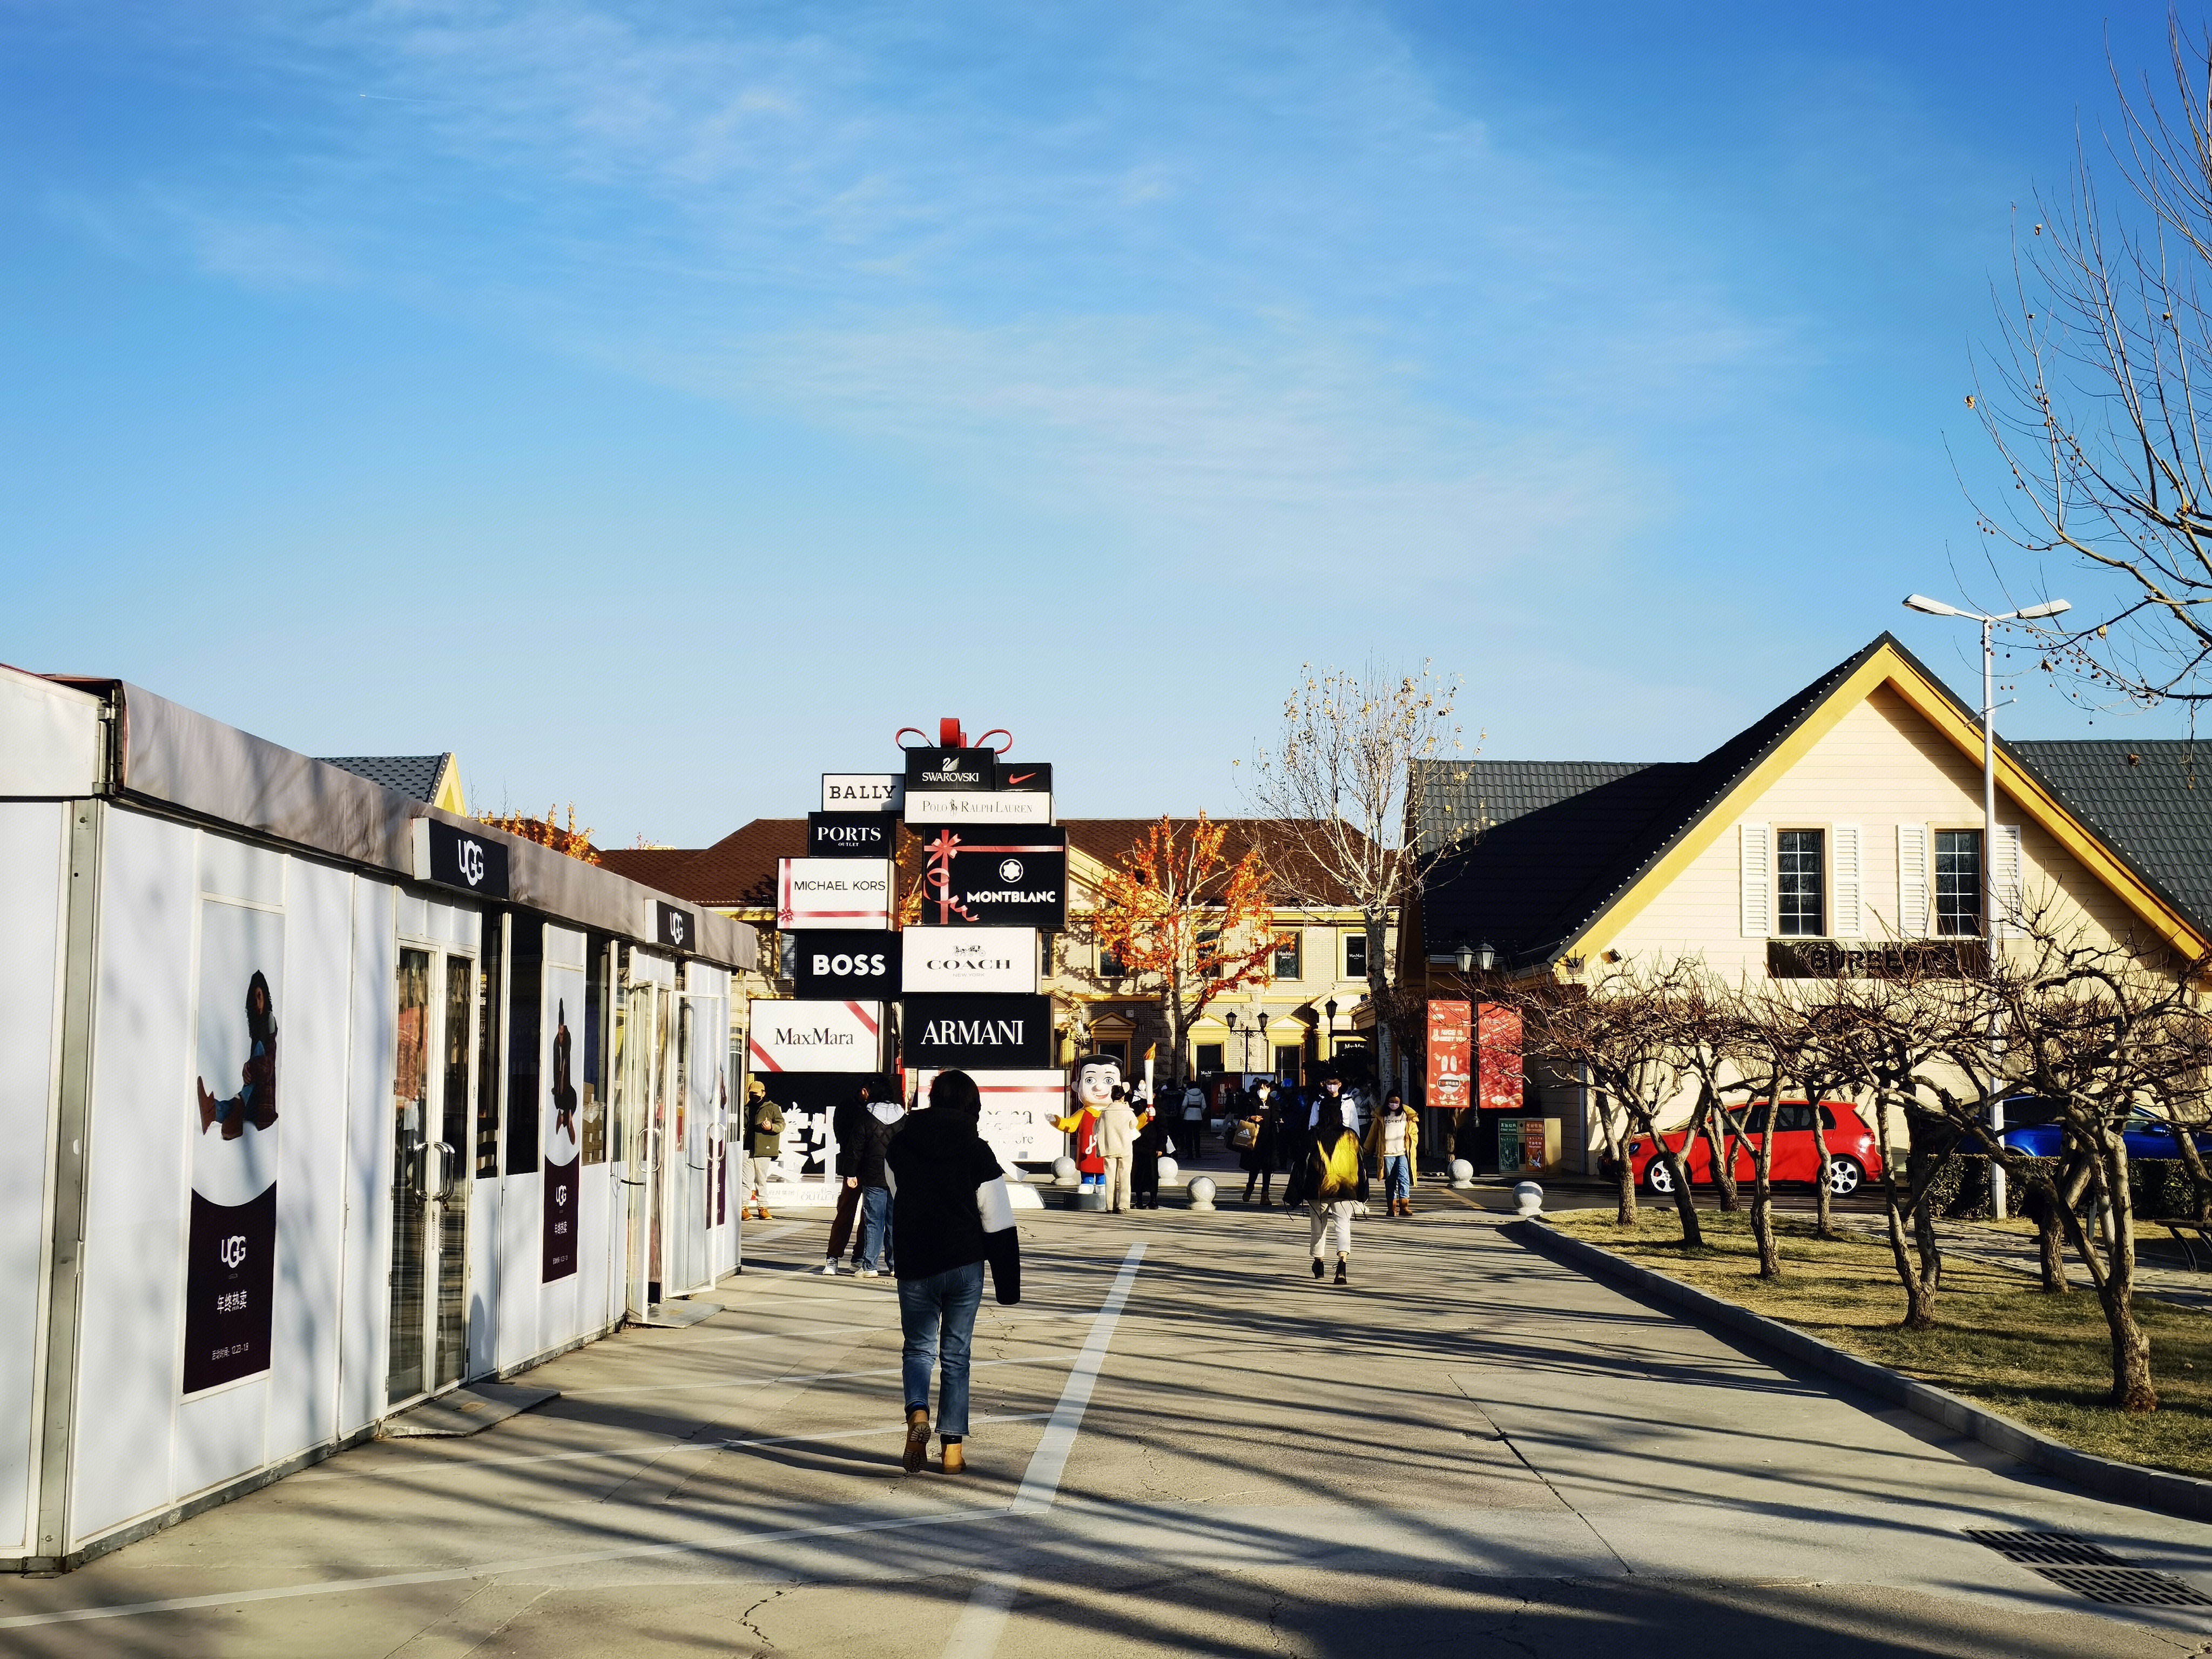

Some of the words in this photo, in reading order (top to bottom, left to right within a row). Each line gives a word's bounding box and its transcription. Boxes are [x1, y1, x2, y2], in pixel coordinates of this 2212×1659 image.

[922, 772, 979, 782] SWAROVSKI
[829, 785, 896, 799] BALLY
[961, 800, 993, 813] RALPH
[995, 800, 1033, 813] LAUREN
[817, 827, 881, 841] PORTS
[457, 839, 484, 886] UGG
[794, 880, 848, 892] MICHAEL
[853, 880, 886, 892] KORS
[967, 891, 1056, 903] MONTBLANC
[670, 912, 683, 945] UGG
[813, 954, 886, 975] BOSS
[927, 960, 1011, 970] COACH
[774, 1028, 854, 1046] MaxMara
[920, 1020, 1024, 1046] ARMANI
[556, 1185, 567, 1206] UGG
[221, 1235, 247, 1269] UGG
[217, 1289, 248, 1315] 年终热卖
